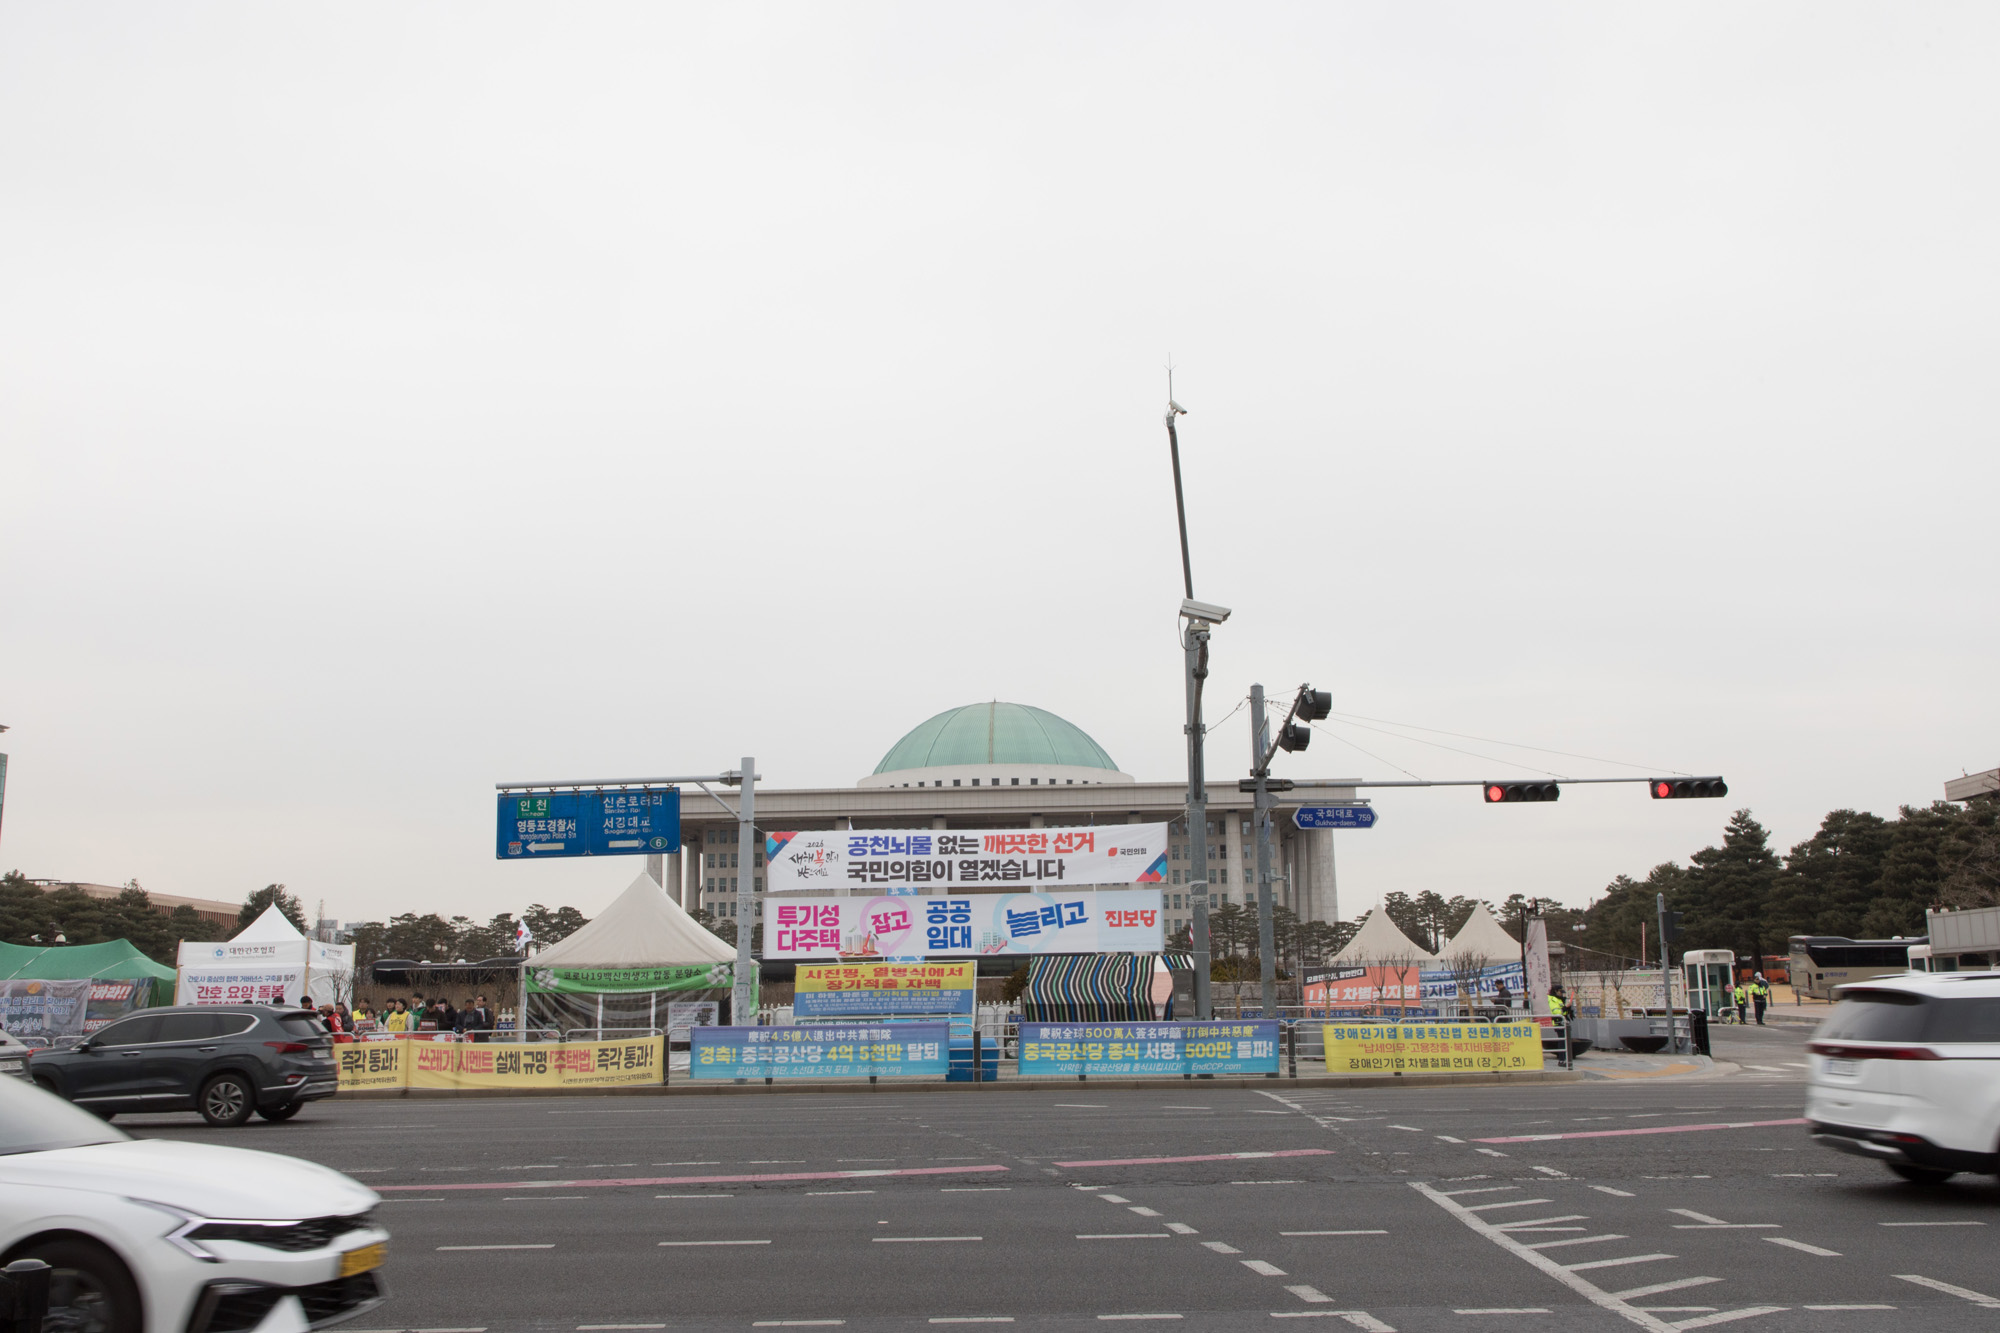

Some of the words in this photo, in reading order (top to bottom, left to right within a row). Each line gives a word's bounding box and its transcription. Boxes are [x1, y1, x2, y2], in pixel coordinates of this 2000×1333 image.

[603, 795, 662, 808] 신촌로터리
[1316, 809, 1354, 818] 국회대로
[517, 819, 576, 832] 영등포경찰서
[603, 816, 650, 828] 서강대교
[656, 839, 661, 847] 6
[805, 839, 824, 848] 2026
[847, 834, 932, 857] 공천뇌물
[937, 835, 980, 856] 없는
[984, 833, 1048, 855] 깨끗한
[1052, 831, 1095, 854] 선거
[788, 851, 814, 864] 새해
[814, 848, 824, 868] 복
[825, 851, 839, 863] 많이
[1120, 848, 1147, 856] 국민의힘
[797, 866, 829, 878] 받으세요
[847, 859, 953, 883] 국민의힘이
[959, 857, 1065, 881] 열겠습니다
[777, 905, 840, 928] 투기성
[926, 900, 971, 923] 공공
[870, 911, 913, 934] 잡고
[1006, 900, 1089, 938] 늘리고
[1105, 910, 1157, 928] 진보당
[777, 930, 841, 952] 다주택
[926, 925, 972, 949] 임대
[229, 946, 275, 954] 대한간호협회
[653, 970, 671, 980] 합동
[805, 969, 866, 980] 시진핑,
[873, 966, 964, 978] 열병식에서
[826, 979, 898, 990] 장기적출
[906, 978, 941, 989] 자백
[197, 985, 284, 999] 간호·요양·돌봄
[748, 1029, 892, 1043] 慶祝4.5億人退出中共黨團隊
[1333, 1027, 1398, 1040] 장애인기업
[1403, 1027, 1462, 1040] 활동촉진법
[1467, 1026, 1533, 1038] 전면개정하라
[699, 1046, 737, 1064] 경축!
[742, 1045, 823, 1063] 중국공산당
[827, 1045, 854, 1062] 4억
[859, 1043, 902, 1062] 5천만
[908, 1042, 939, 1060] 탈퇴
[1024, 1042, 1104, 1061] 중국공산당
[1108, 1042, 1140, 1060] 종식
[1144, 1042, 1181, 1061] 서명,
[1185, 1041, 1233, 1059] 500만
[1236, 1040, 1273, 1058] 돌파!
[342, 1049, 367, 1074] 즉각
[369, 1048, 398, 1072] 통과!
[417, 1048, 454, 1072] 쓰레기
[457, 1049, 494, 1074] 시멘트
[496, 1050, 521, 1074] 실체
[522, 1050, 548, 1074] 규명
[597, 1047, 622, 1071] 즉각
[623, 1044, 654, 1069] 통과!
[1192, 1061, 1242, 1071] EndCCP.com
[1349, 1058, 1405, 1069] 장애인기업
[1408, 1057, 1451, 1068] 차별철폐
[1454, 1057, 1474, 1068] 연대
[856, 1064, 902, 1075] TuiDang.org
[1084, 1063, 1131, 1072] 중국공산당을
